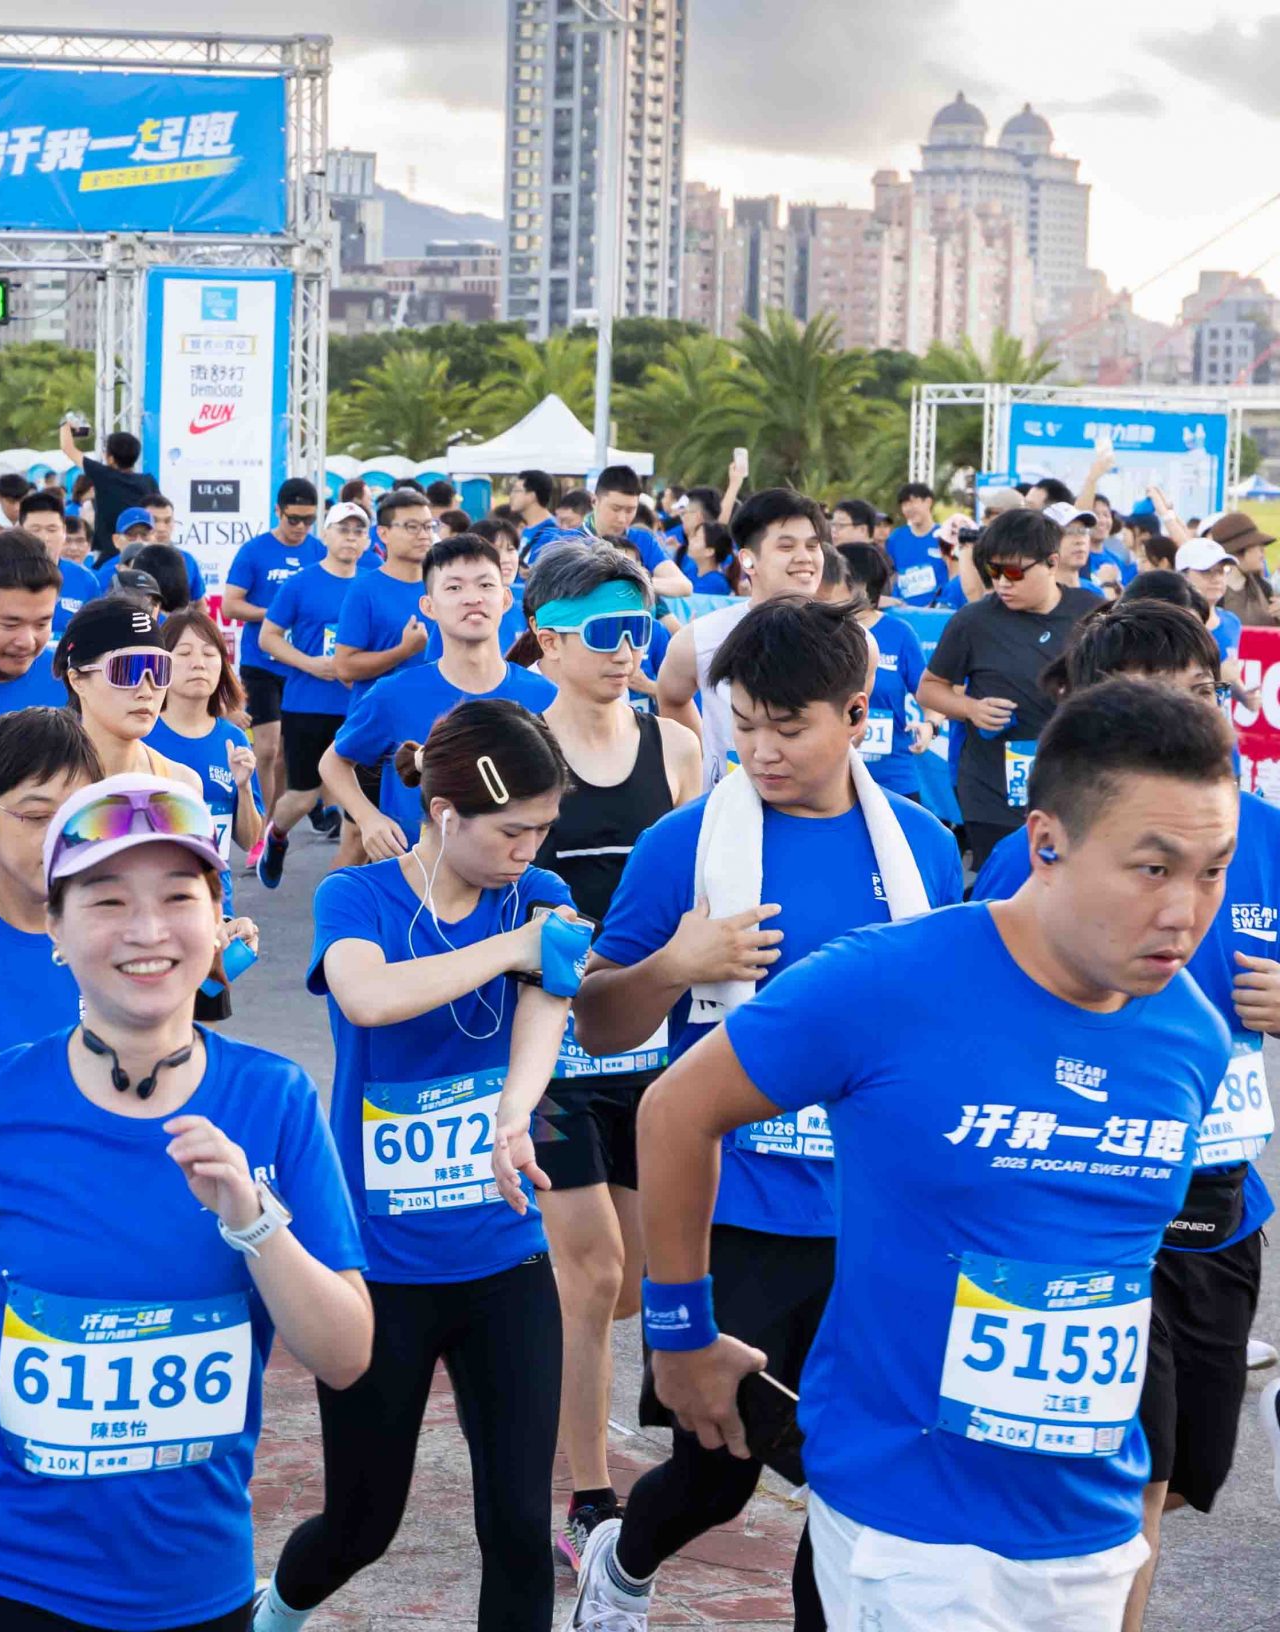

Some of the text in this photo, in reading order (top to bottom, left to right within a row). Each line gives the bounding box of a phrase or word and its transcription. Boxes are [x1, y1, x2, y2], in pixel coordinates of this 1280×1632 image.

[191, 383, 243, 398] DemiSoda
[199, 404, 235, 421] RUN
[1056, 1058, 1107, 1080] POCARI
[1056, 1070, 1101, 1088] SWEAT
[763, 1121, 795, 1136] 026
[943, 1103, 1190, 1161] 汗我一起跑
[990, 1156, 1173, 1180] 2025 POCARI SWEAT RUN
[408, 1197, 432, 1207] 10K
[963, 1313, 1139, 1385] 51532
[13, 1346, 234, 1412] 61186
[996, 1425, 1028, 1441] 10K
[47, 1455, 80, 1471] 10K
